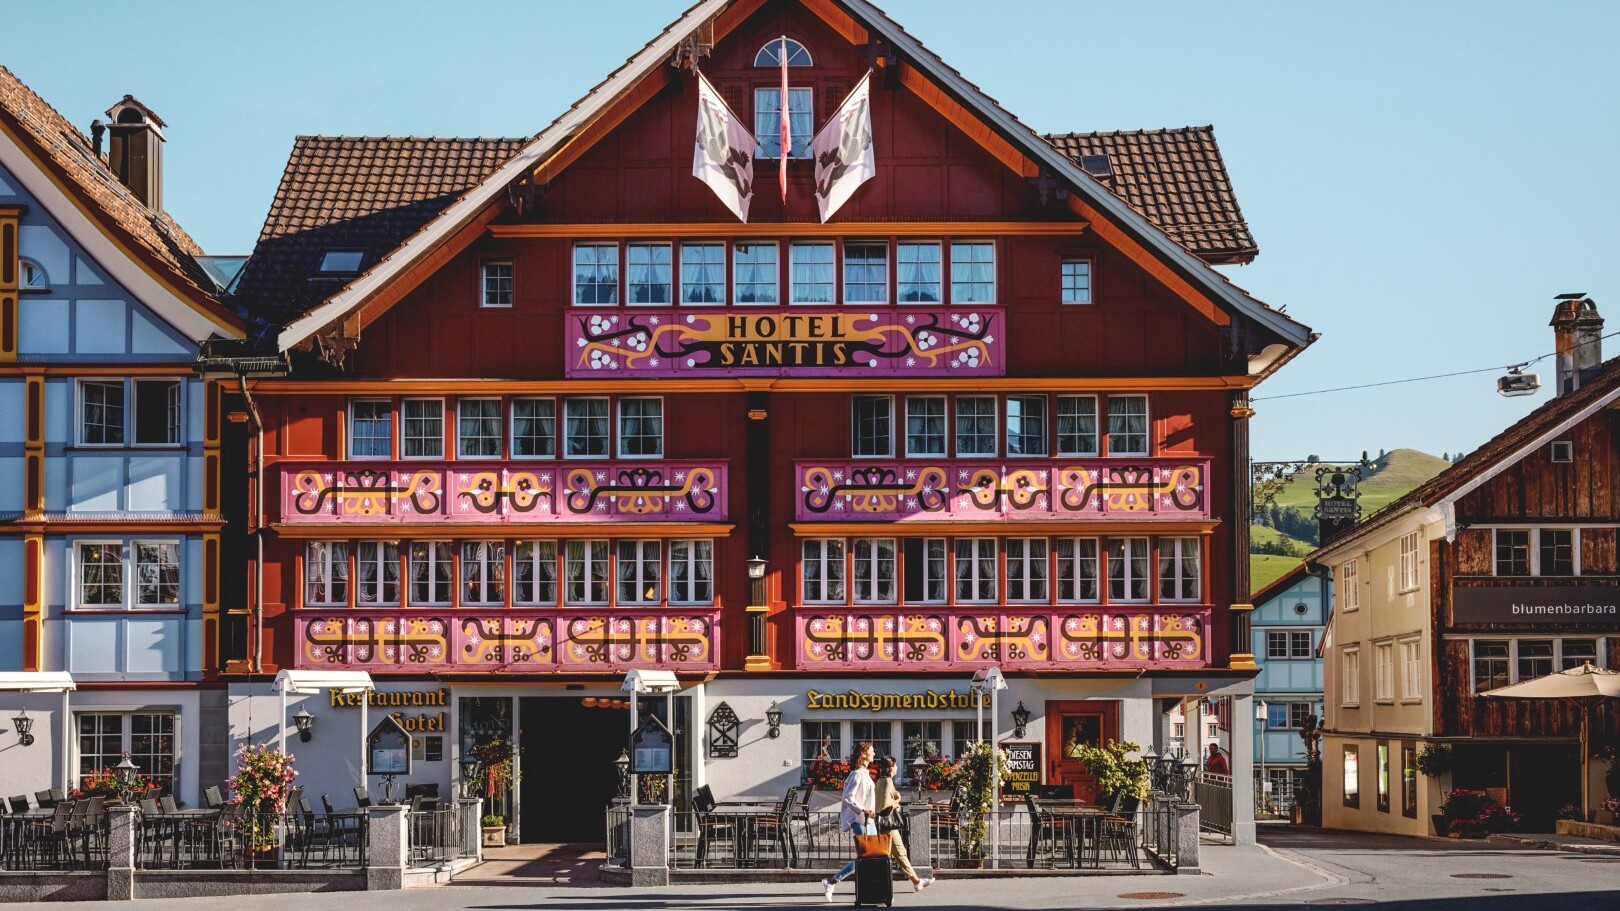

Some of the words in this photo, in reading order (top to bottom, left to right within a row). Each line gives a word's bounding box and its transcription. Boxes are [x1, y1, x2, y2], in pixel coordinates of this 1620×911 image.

[728, 316, 847, 338] HOTEL
[720, 342, 847, 365] SÄNTIS
[1512, 603, 1616, 614] blumenbarbara
